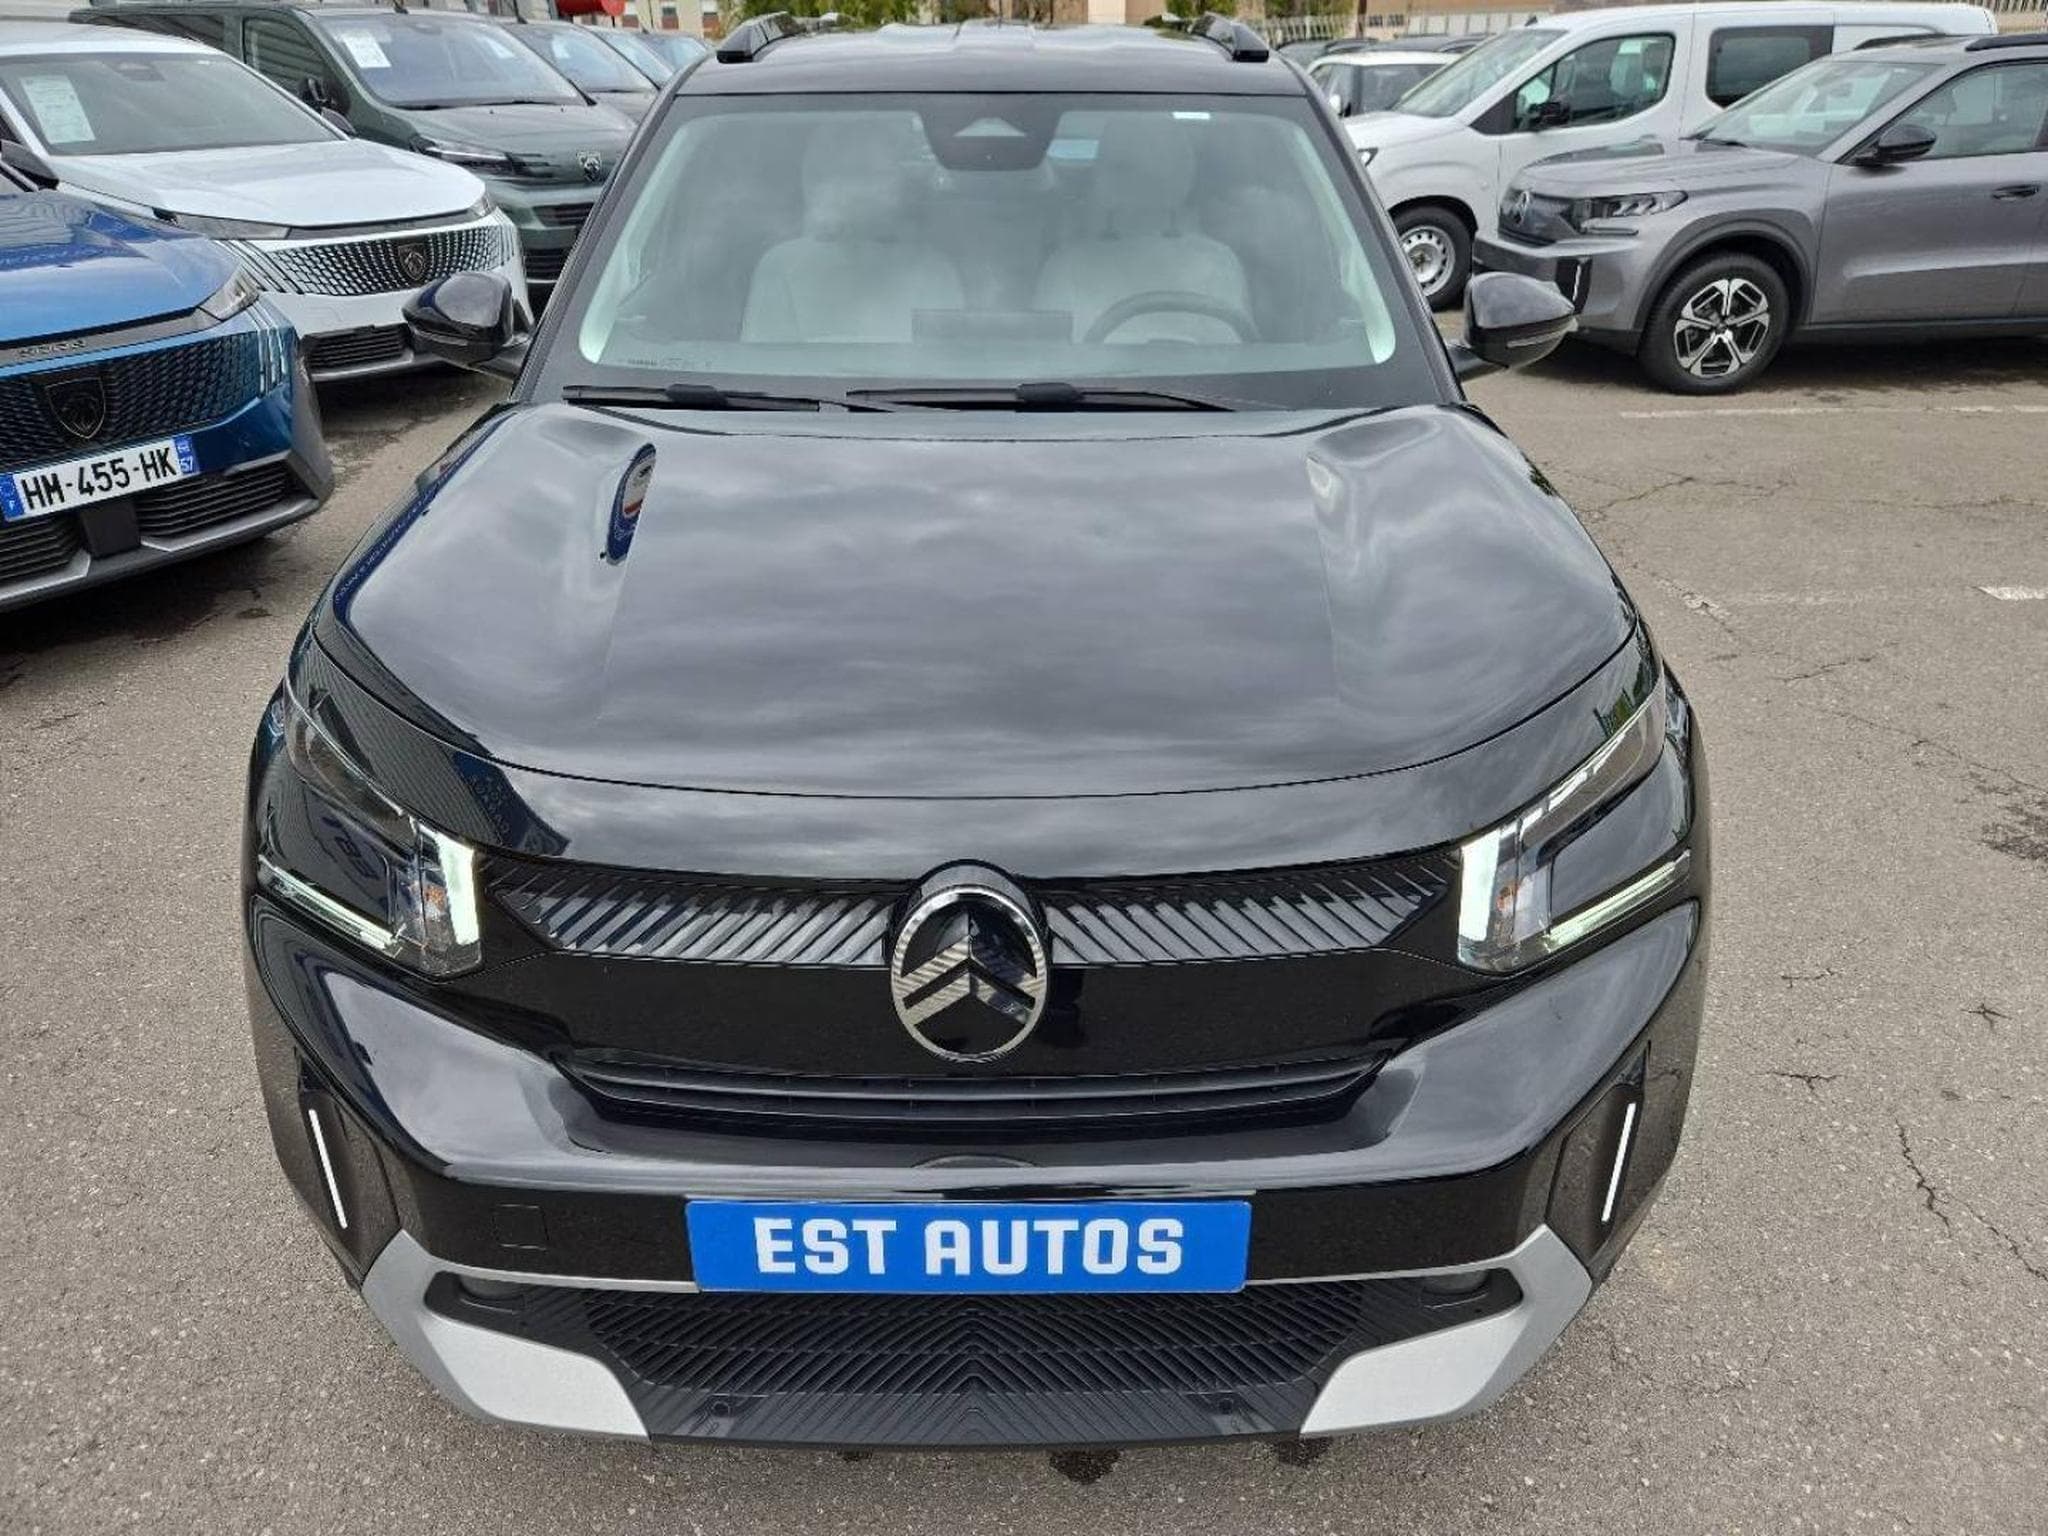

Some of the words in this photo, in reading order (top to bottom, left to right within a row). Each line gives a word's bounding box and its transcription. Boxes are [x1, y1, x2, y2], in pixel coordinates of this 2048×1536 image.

[21, 447, 177, 510] HM-455-HK
[179, 454, 194, 472] 57
[753, 1217, 897, 1275] EST
[924, 1218, 1184, 1275] AUTOS
